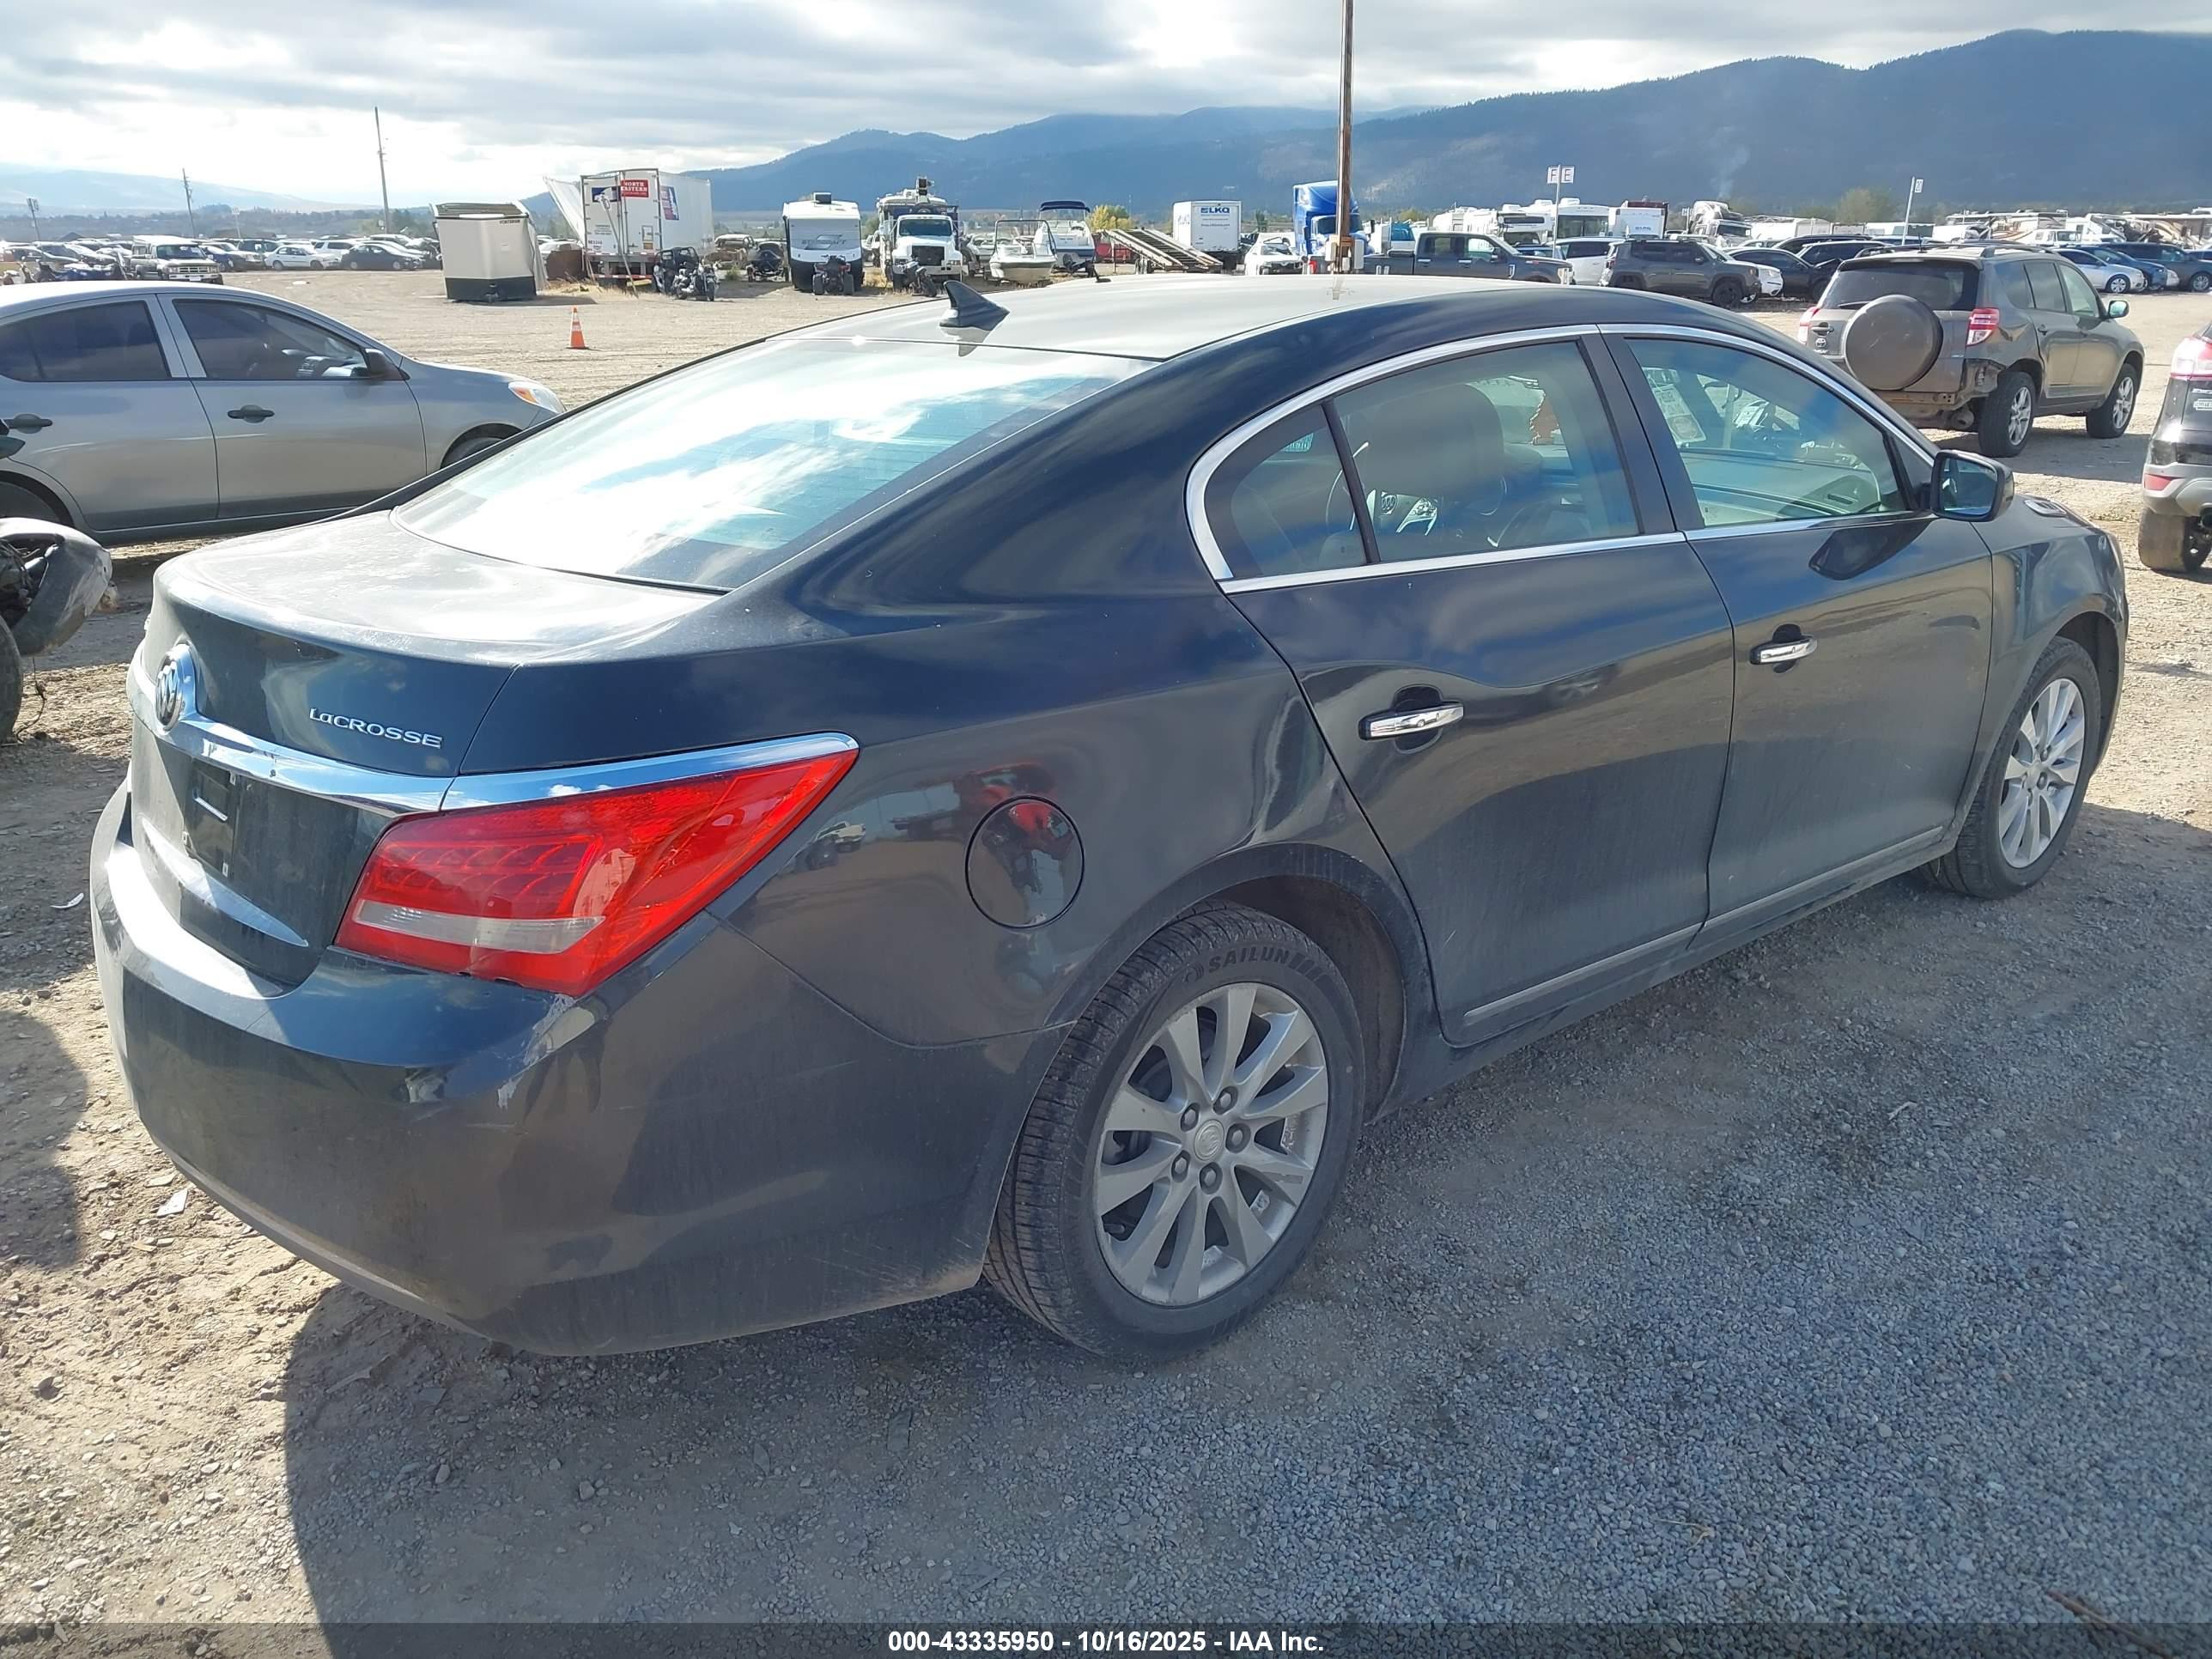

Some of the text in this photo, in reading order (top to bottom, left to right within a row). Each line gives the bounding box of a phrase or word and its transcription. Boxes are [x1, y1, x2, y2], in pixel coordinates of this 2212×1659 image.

[1550, 168, 1558, 181] F
[1564, 168, 1572, 181] E
[309, 708, 443, 750] LaCROSSE
[1208, 946, 1290, 974] SAILUN
